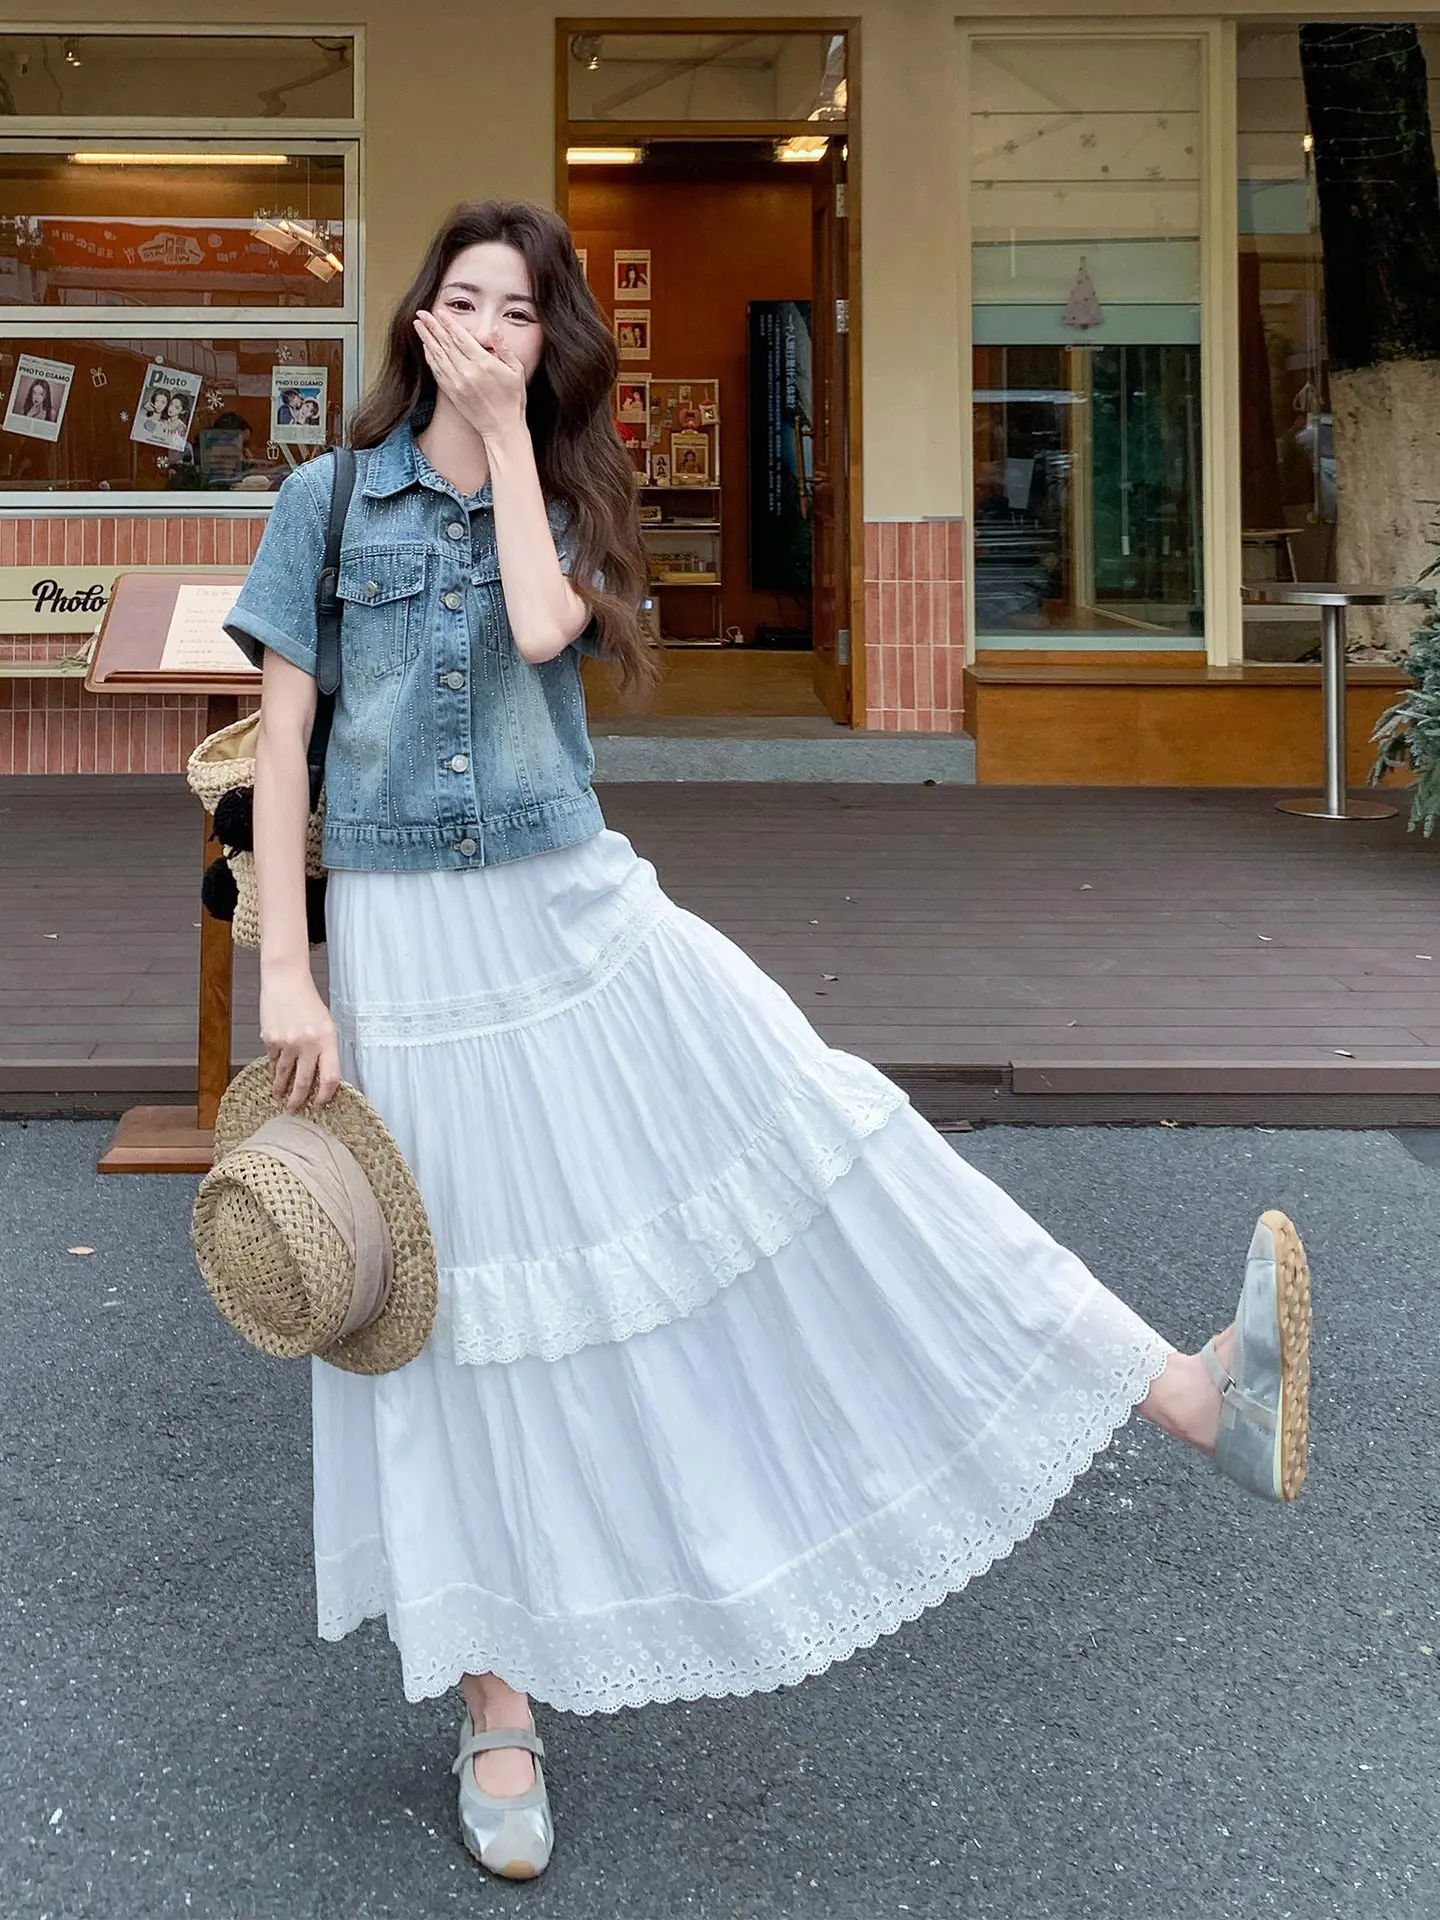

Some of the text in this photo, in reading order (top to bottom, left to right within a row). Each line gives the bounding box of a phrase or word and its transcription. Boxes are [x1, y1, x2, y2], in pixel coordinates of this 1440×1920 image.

[19, 366, 45, 376] PHOTO
[149, 369, 187, 387] Photo
[32, 579, 108, 613] Photo
